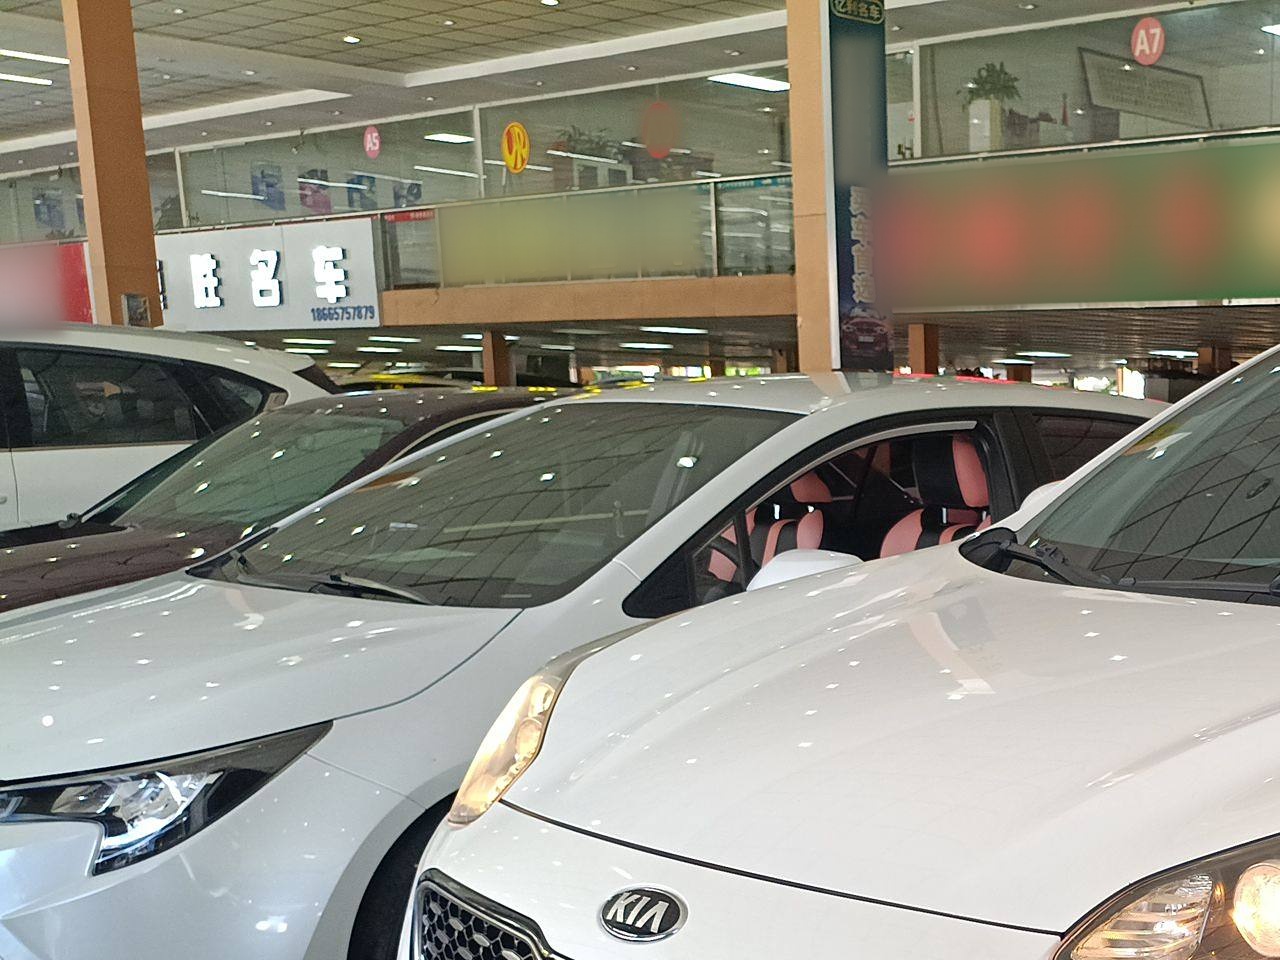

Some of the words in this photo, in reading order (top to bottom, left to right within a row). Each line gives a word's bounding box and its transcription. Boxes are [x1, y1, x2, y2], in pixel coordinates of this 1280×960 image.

[1134, 27, 1161, 57] A7
[365, 132, 379, 152] A5
[606, 891, 670, 933] KIA
